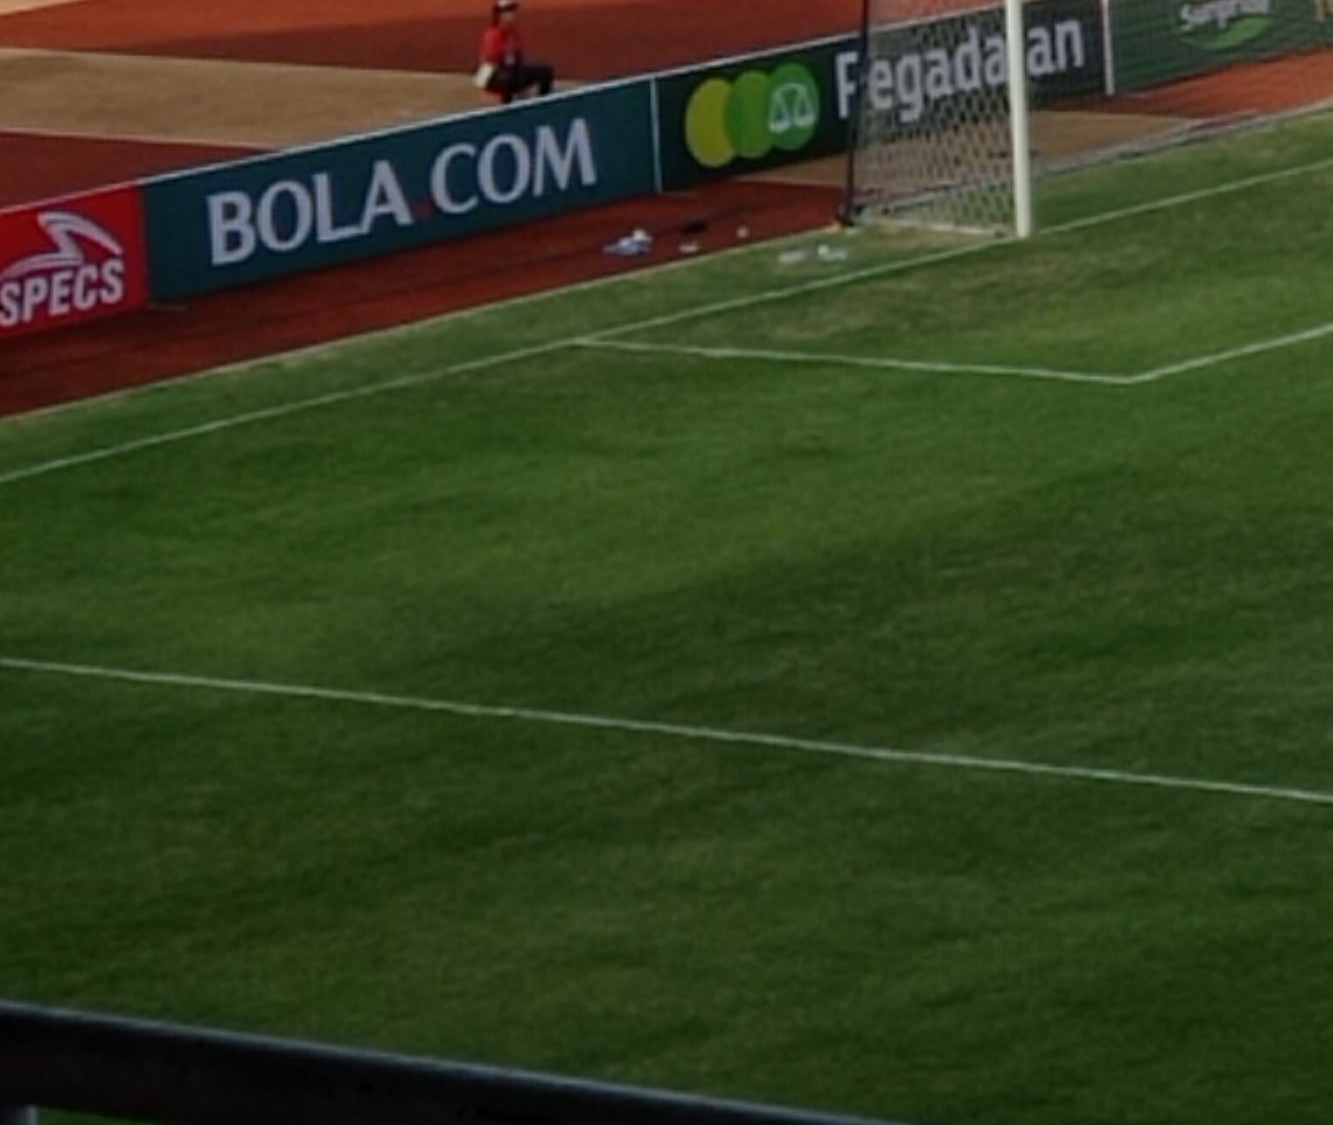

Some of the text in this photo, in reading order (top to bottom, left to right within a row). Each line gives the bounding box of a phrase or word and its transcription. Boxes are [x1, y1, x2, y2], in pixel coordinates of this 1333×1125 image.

[834, 19, 1086, 122] Pegadaan
[206, 116, 599, 268] BOLA.COM
[0, 256, 125, 328] SPECS
